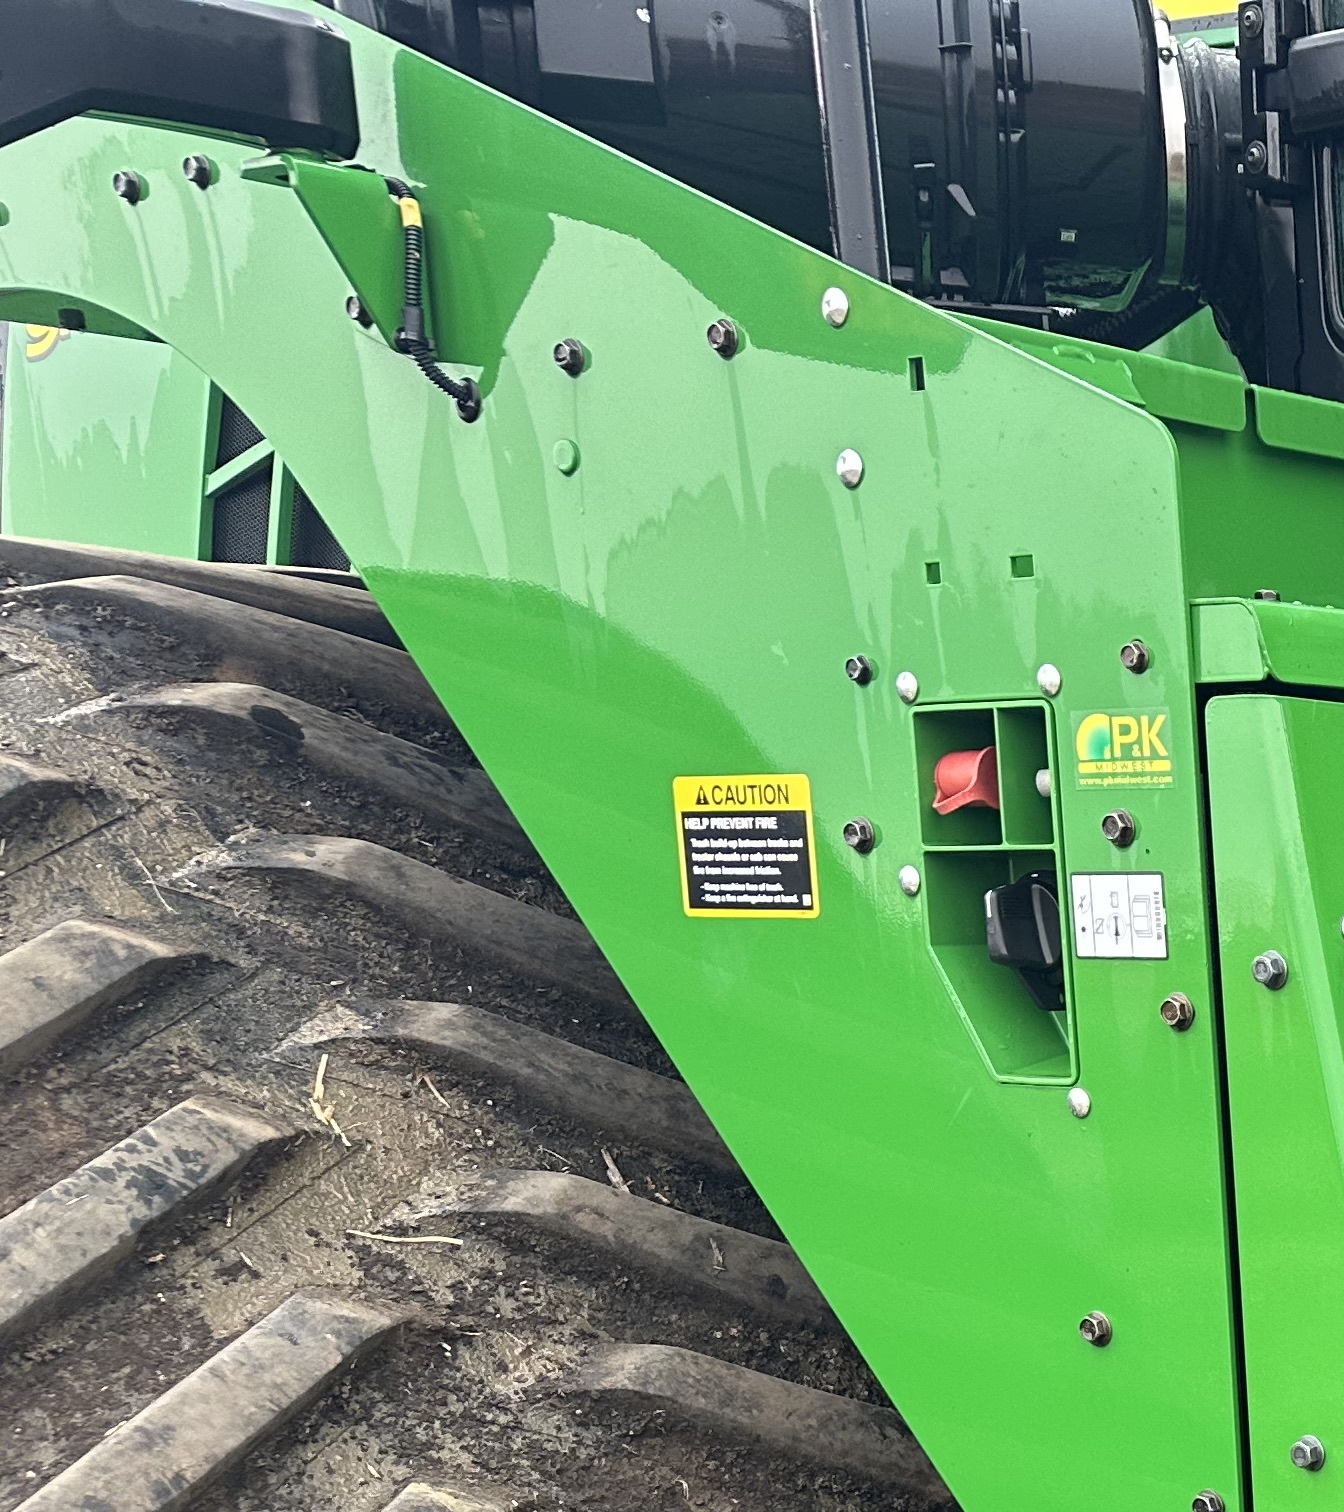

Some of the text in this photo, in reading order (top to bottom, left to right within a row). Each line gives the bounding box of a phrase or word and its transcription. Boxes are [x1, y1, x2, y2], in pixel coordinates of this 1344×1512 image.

[1111, 714, 1168, 758] P&K
[1095, 761, 1154, 772] MIDWEST
[711, 784, 790, 806] CAUTION
[684, 816, 778, 830] HELP PREVENT FIRE
